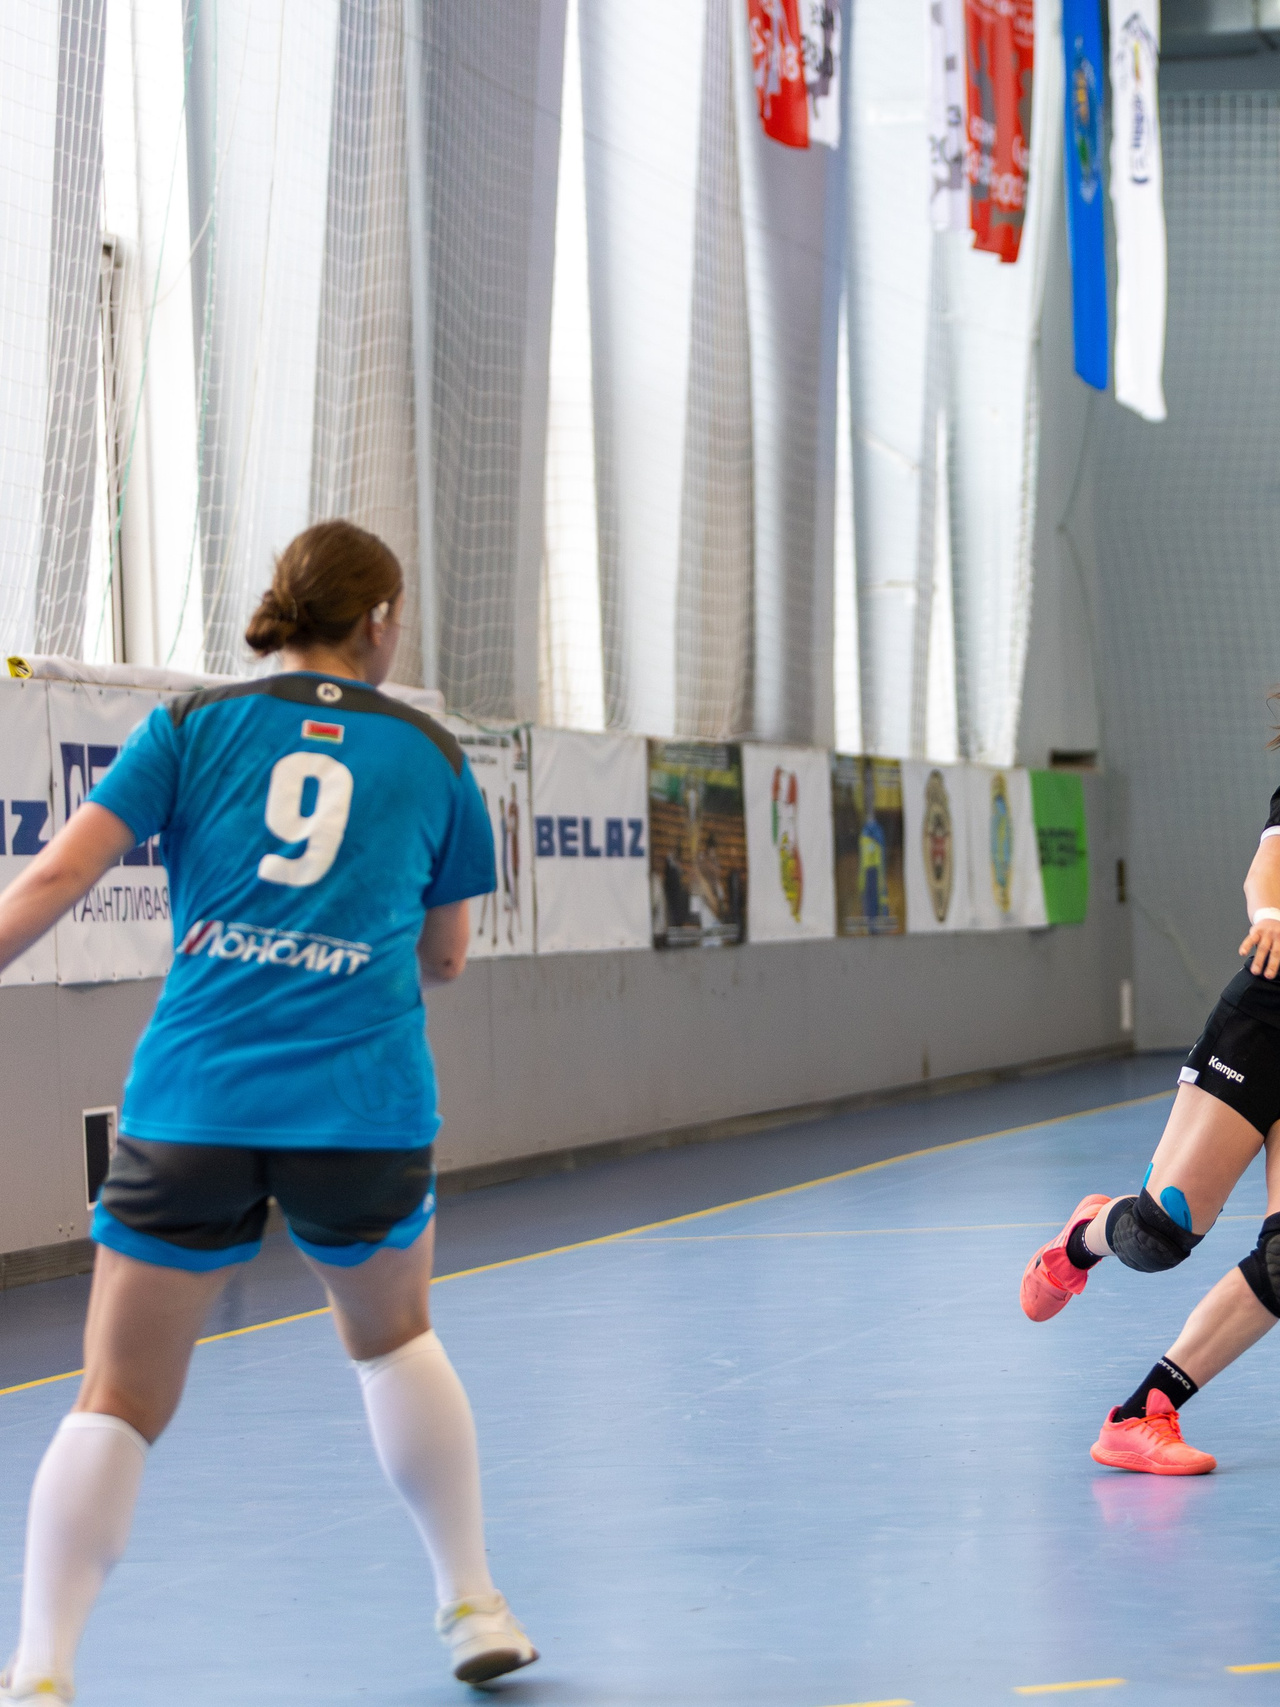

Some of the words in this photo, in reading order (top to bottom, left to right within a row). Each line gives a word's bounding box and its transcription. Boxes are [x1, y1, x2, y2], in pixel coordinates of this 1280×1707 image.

[257, 751, 354, 888] 9
[534, 815, 646, 858] BELAZ
[1208, 1055, 1245, 1083] Kempa
[1158, 1359, 1192, 1390] empa
